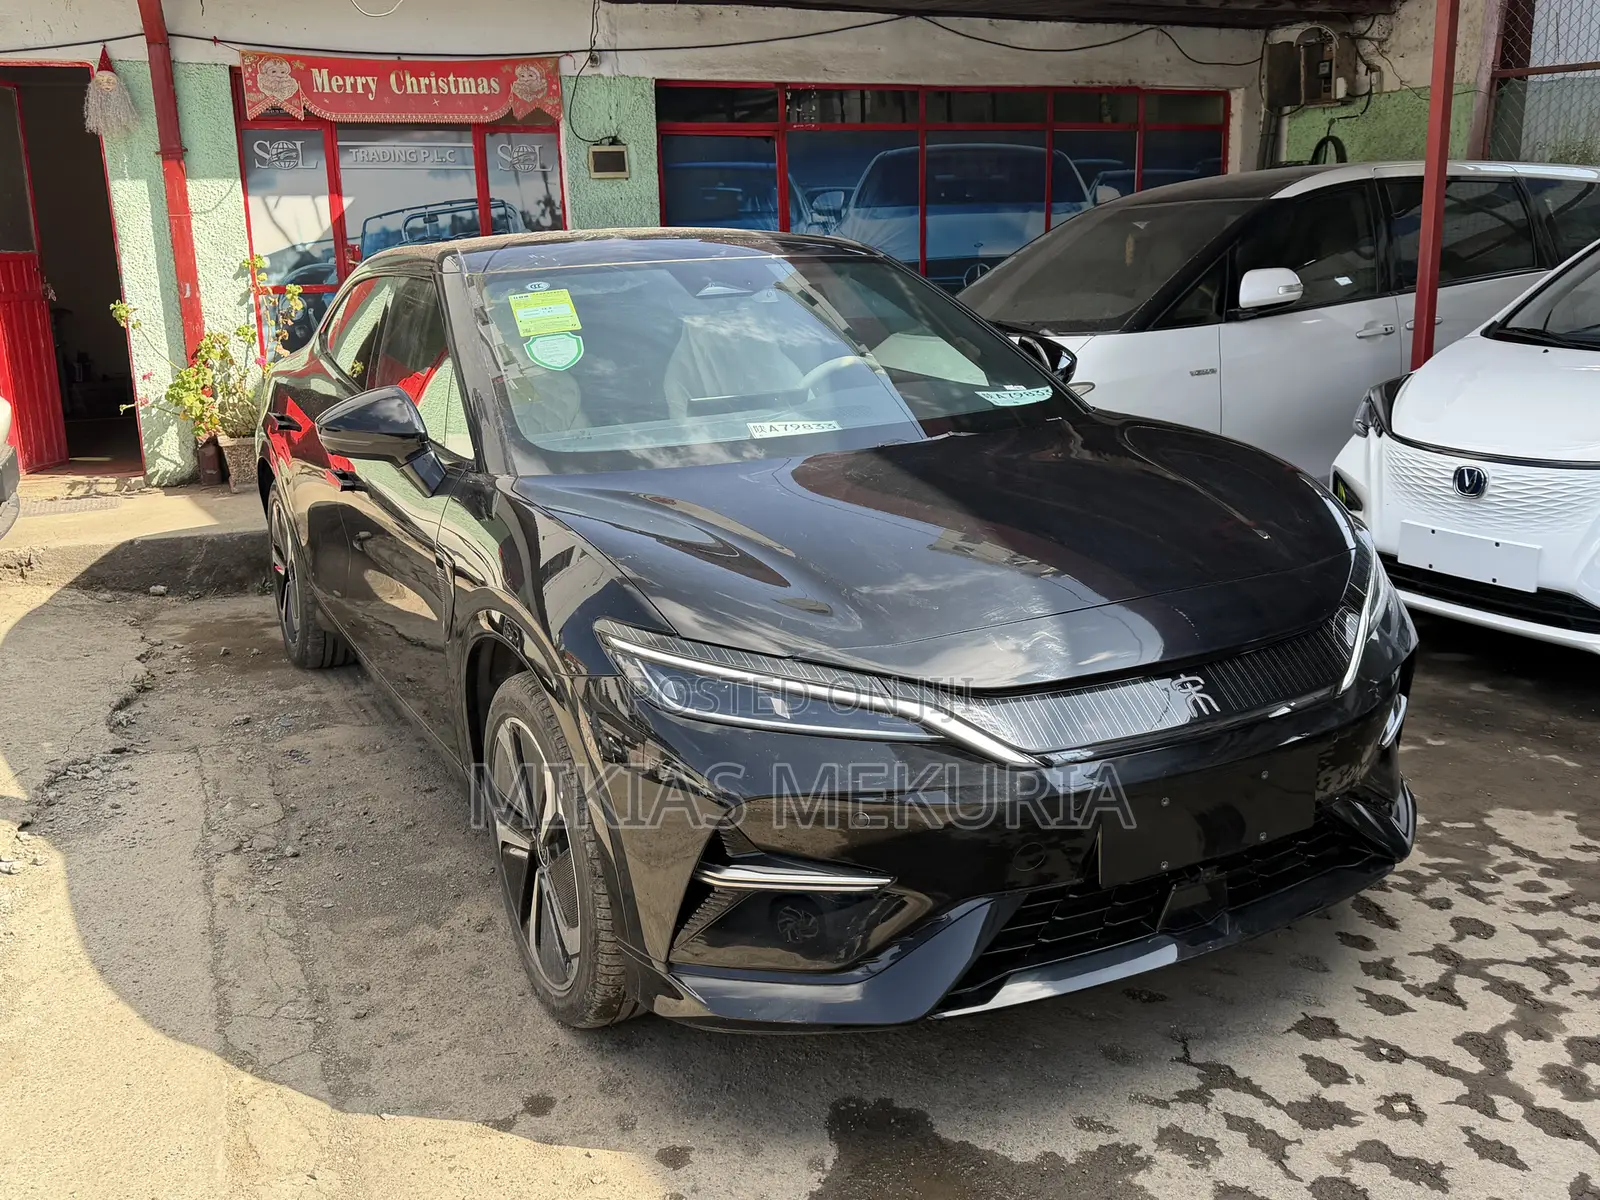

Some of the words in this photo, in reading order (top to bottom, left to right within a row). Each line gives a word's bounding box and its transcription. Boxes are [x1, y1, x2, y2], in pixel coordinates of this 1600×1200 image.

[311, 68, 378, 100] Merry
[390, 68, 500, 96] Christmas
[349, 148, 418, 164] TRADING
[420, 149, 456, 164] P.L.C
